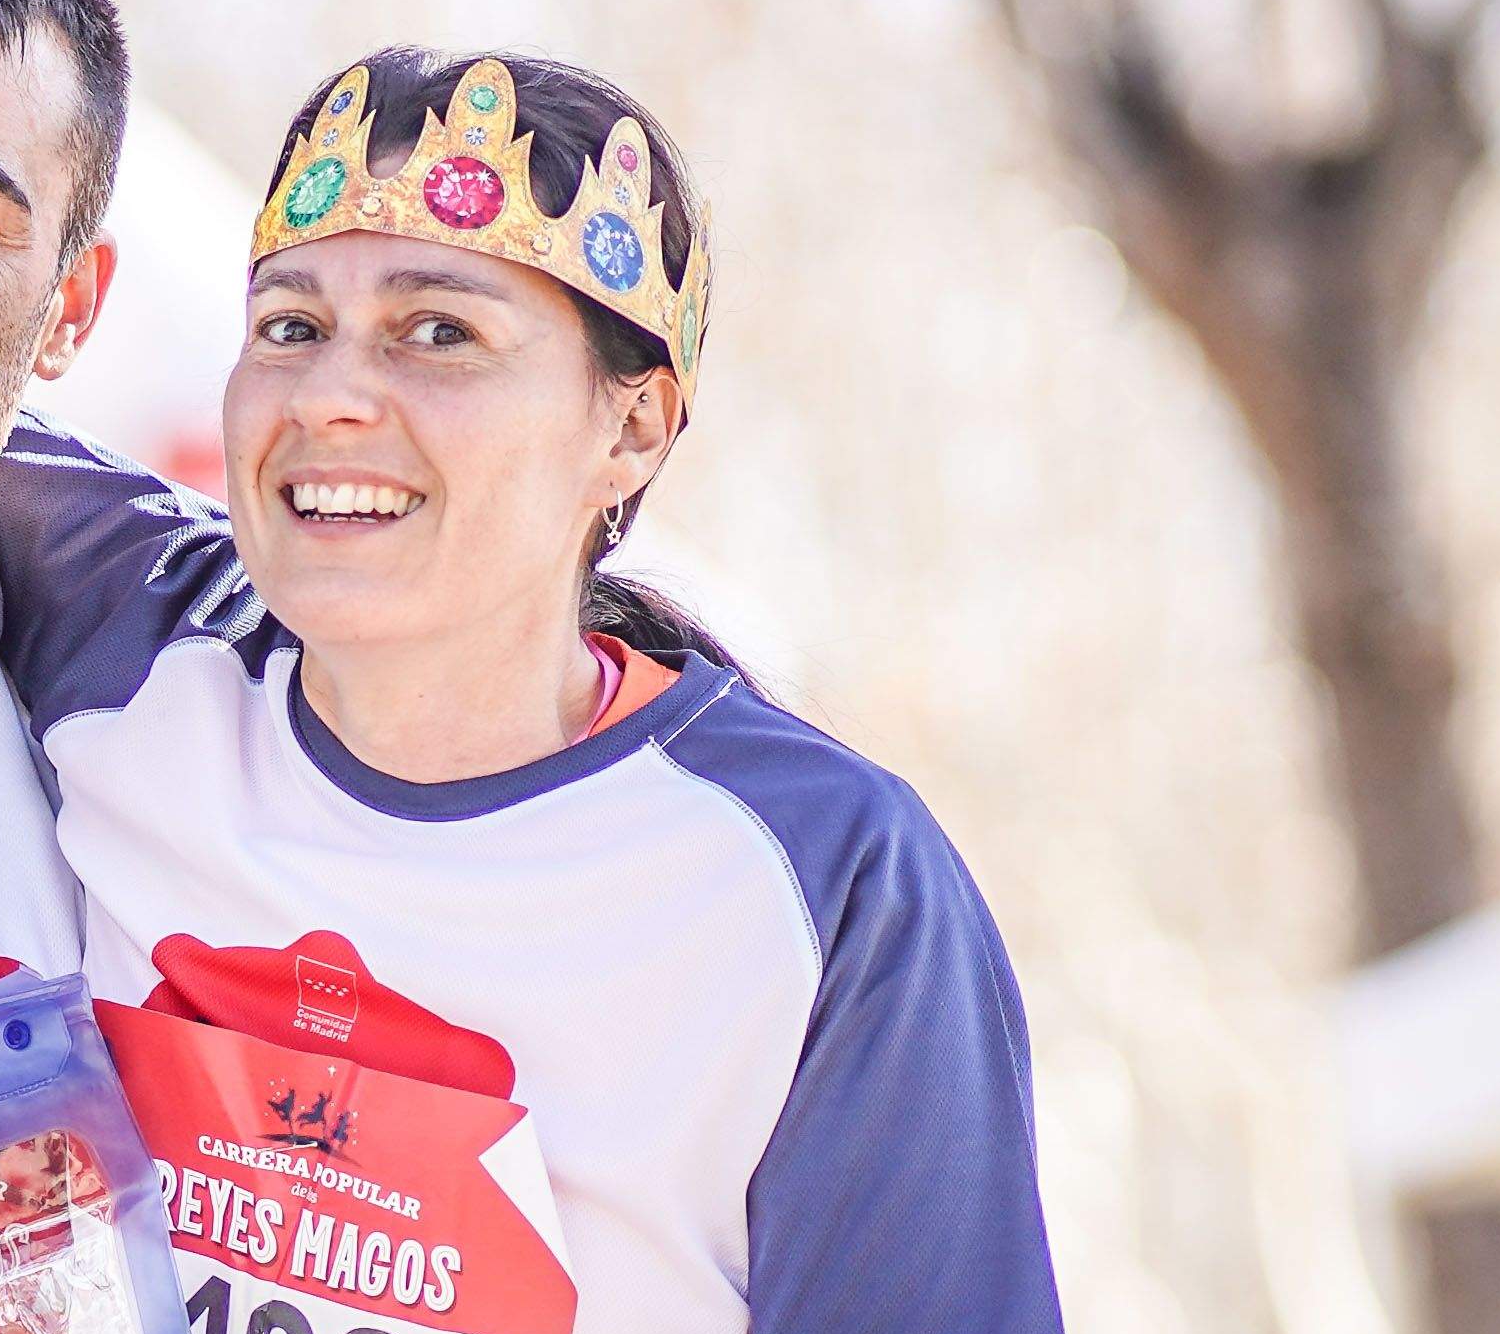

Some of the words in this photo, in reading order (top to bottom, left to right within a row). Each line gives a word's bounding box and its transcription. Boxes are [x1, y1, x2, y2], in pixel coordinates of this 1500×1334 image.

[293, 1018, 308, 1030] de
[309, 1022, 349, 1043] Madrid
[296, 1008, 353, 1033] Comunidad
[197, 1135, 311, 1179] CARRERA
[290, 1181, 308, 1198] de
[151, 1158, 284, 1265] REYES
[289, 1208, 463, 1313] MAGOS
